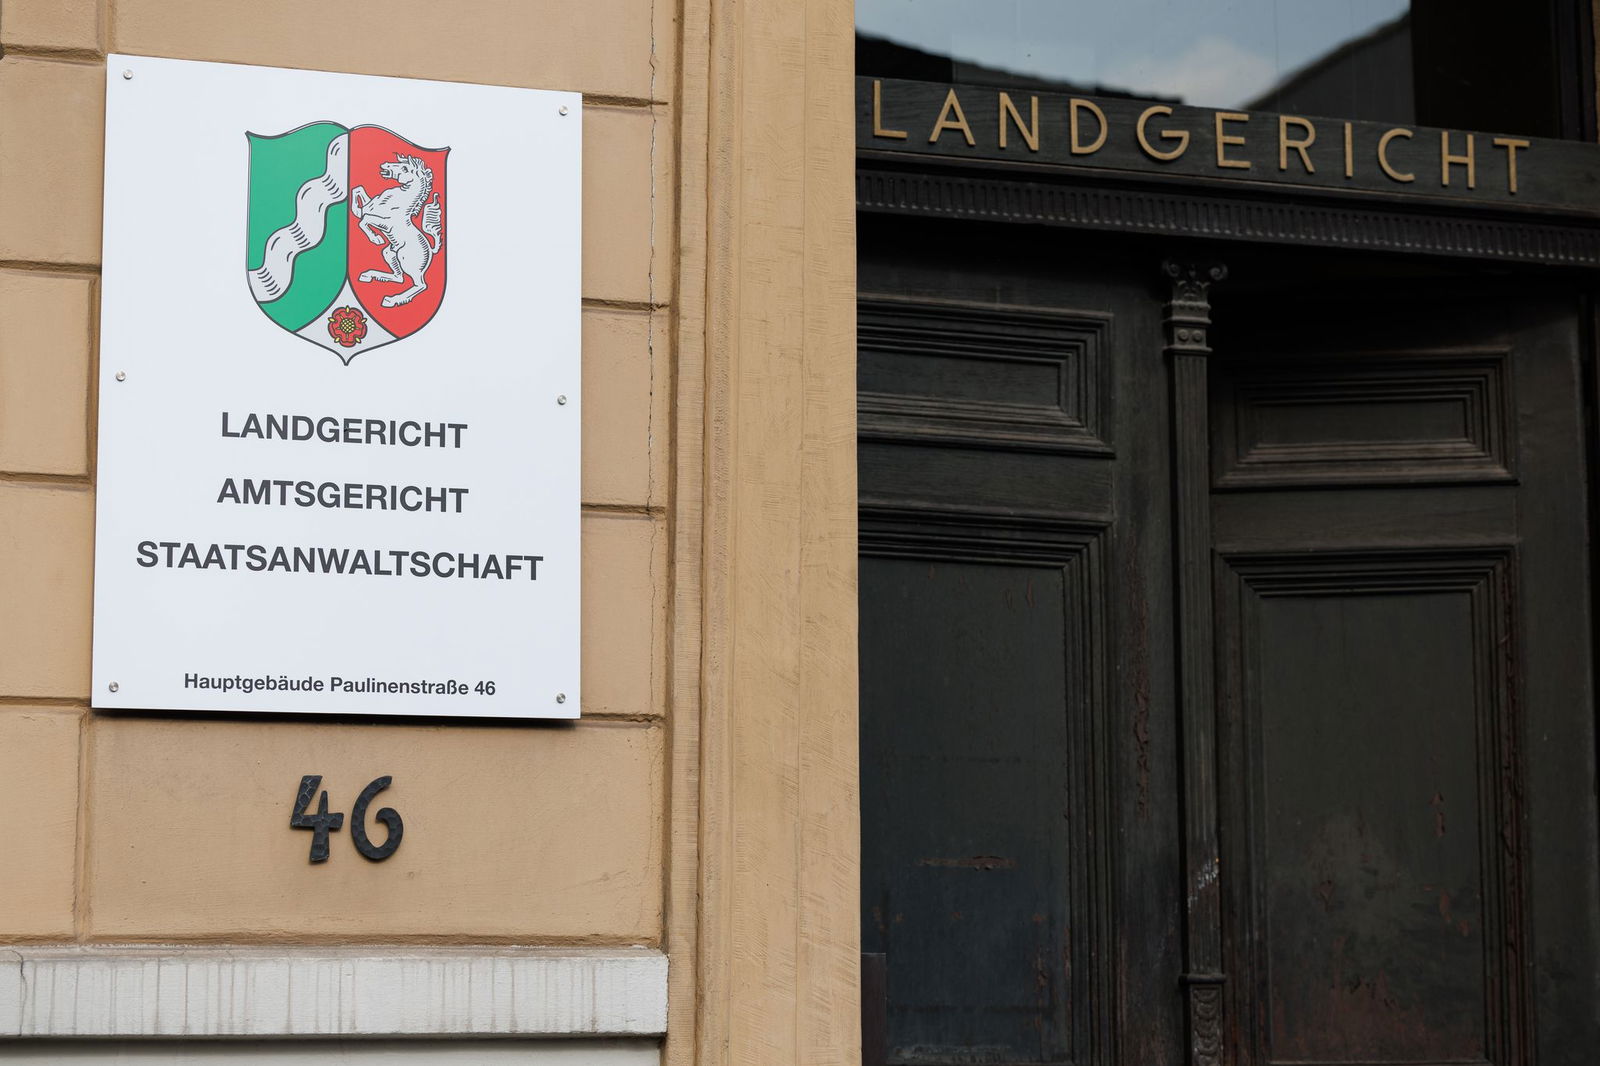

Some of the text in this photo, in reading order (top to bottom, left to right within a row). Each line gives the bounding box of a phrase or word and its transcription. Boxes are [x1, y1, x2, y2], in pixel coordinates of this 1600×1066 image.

[873, 80, 1530, 193] LANDGERICHT
[222, 412, 468, 448] LANDGERICHT
[217, 478, 469, 513] AMTSGERICHT
[136, 541, 543, 580] STAATSANWALTSCHAFT
[184, 673, 496, 696] Hauptgebäude Paulinenstraße 46
[290, 775, 404, 864] 46
